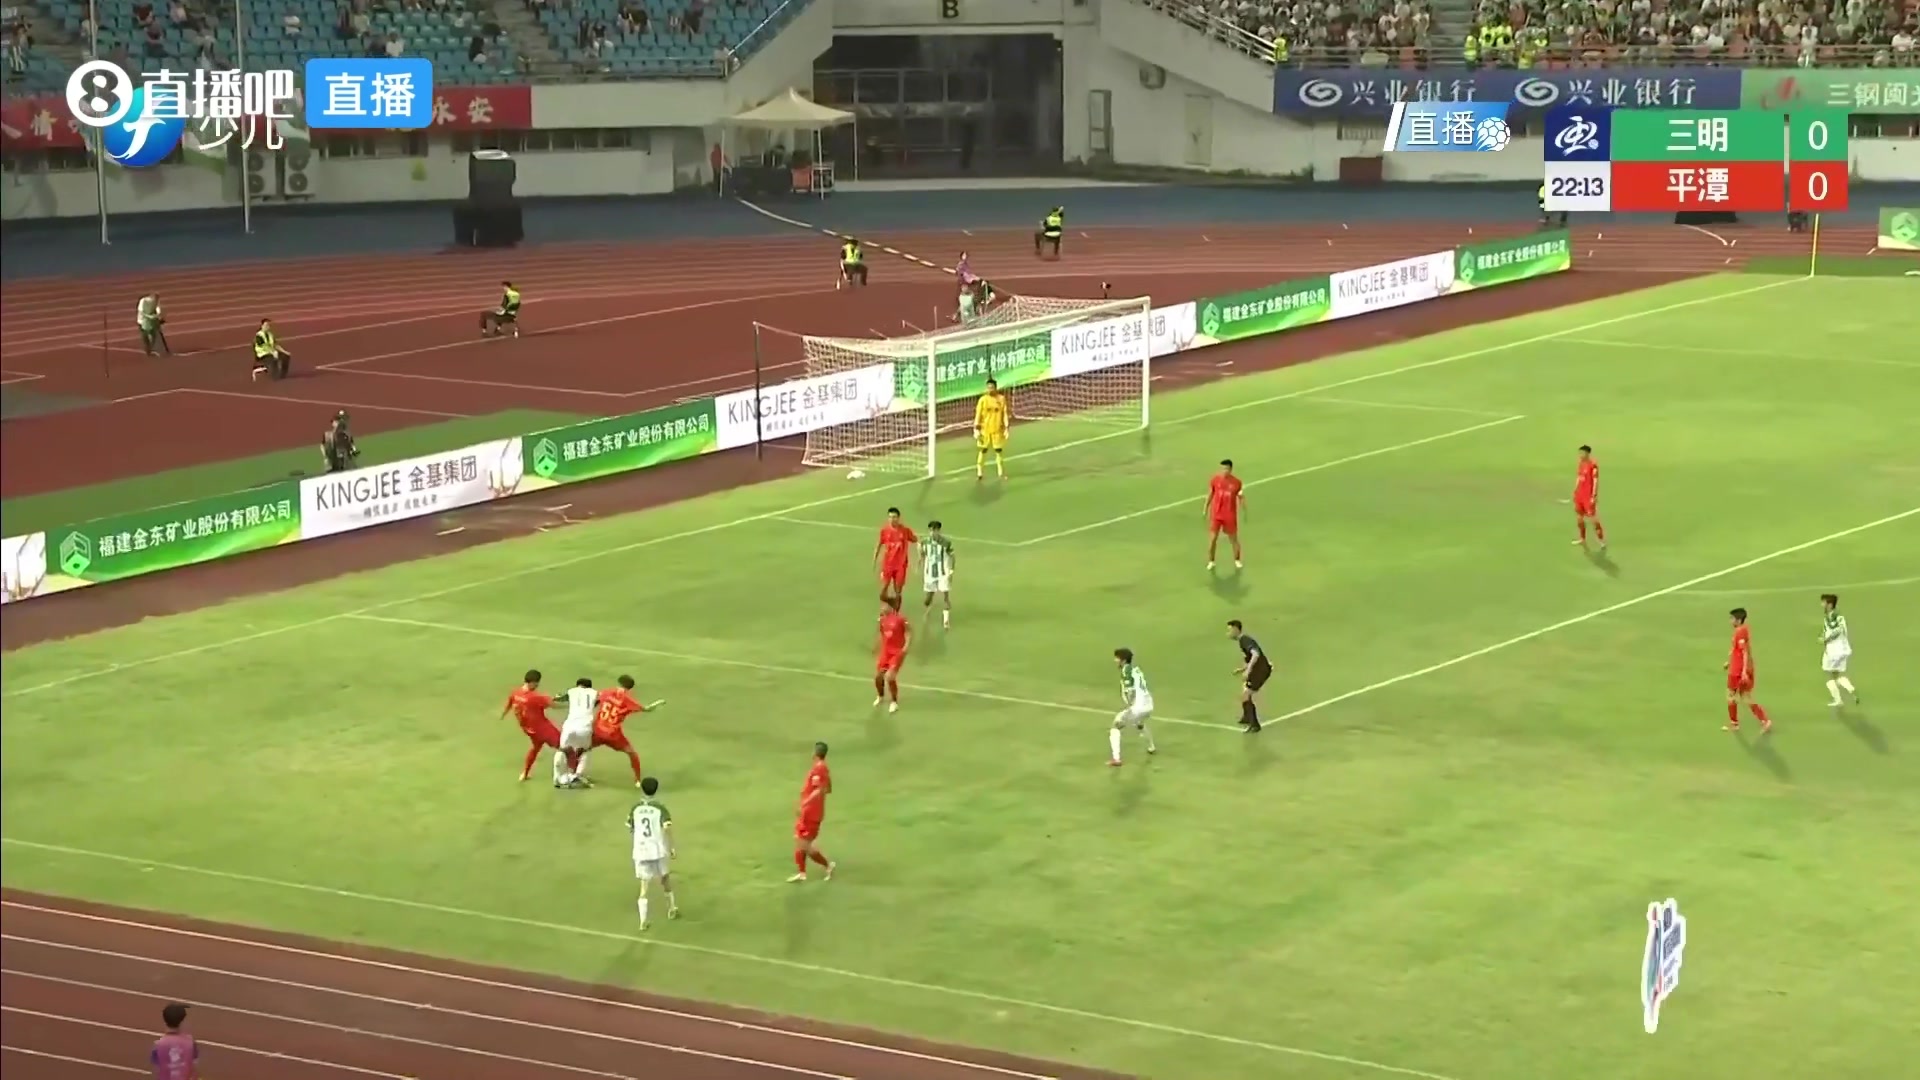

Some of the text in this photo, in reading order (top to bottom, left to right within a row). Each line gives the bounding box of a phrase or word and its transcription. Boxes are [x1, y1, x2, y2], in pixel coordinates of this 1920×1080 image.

[943, 0, 959, 18] B
[1350, 79, 1476, 105] 兴业银行
[1566, 78, 1696, 105] 兴业银行
[1338, 270, 1386, 299] KINGJEE
[1222, 287, 1325, 323] 福建金东矿业股份有限公司
[728, 390, 797, 425] KINGJEE
[562, 413, 709, 461] 福建金东矿业股份有限公司
[316, 469, 402, 511] KINGJEE
[408, 455, 478, 493] 金基集团
[98, 499, 292, 558] 福建金东矿业股份有限公司
[641, 817, 652, 837] 3
